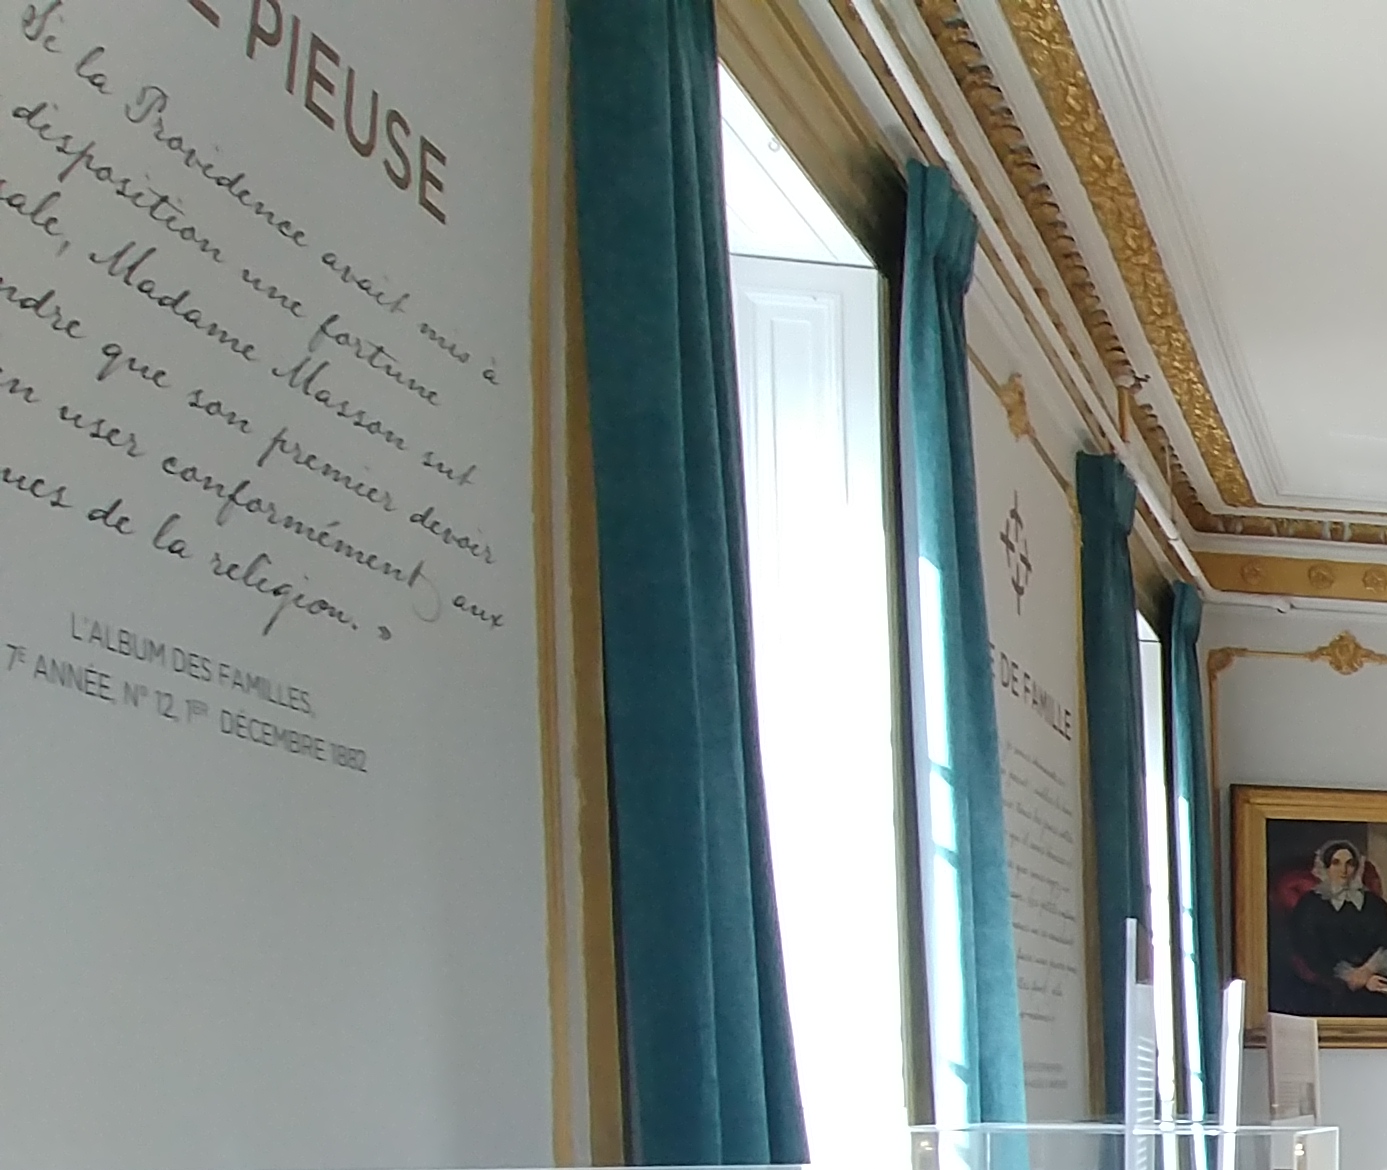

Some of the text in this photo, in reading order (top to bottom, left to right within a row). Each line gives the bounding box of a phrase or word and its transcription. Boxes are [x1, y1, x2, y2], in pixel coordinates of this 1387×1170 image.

[76, 45, 113, 95] la
[125, 85, 307, 248] Providence
[321, 251, 409, 314] avait
[420, 322, 470, 364] mis
[483, 356, 499, 385] à
[246, 0, 448, 225] PIEUSE
[12, 101, 440, 406] disposition une fortune
[90, 240, 257, 363] Madame
[272, 355, 407, 451] Masson
[422, 450, 477, 488] sut
[59, 405, 504, 628] user conformément aux
[97, 343, 171, 388] que
[187, 389, 252, 434] son
[257, 426, 396, 512] premier
[409, 505, 495, 565] devoir
[72, 610, 317, 719] L'ALBUM DES FAMILLES,
[87, 498, 135, 535] de
[153, 513, 193, 559] la
[209, 552, 357, 637] religion.
[220, 708, 329, 762] DÉCEMBRE
[1000, 651, 1019, 697] DE
[1023, 671, 1072, 741] FAMILLE
